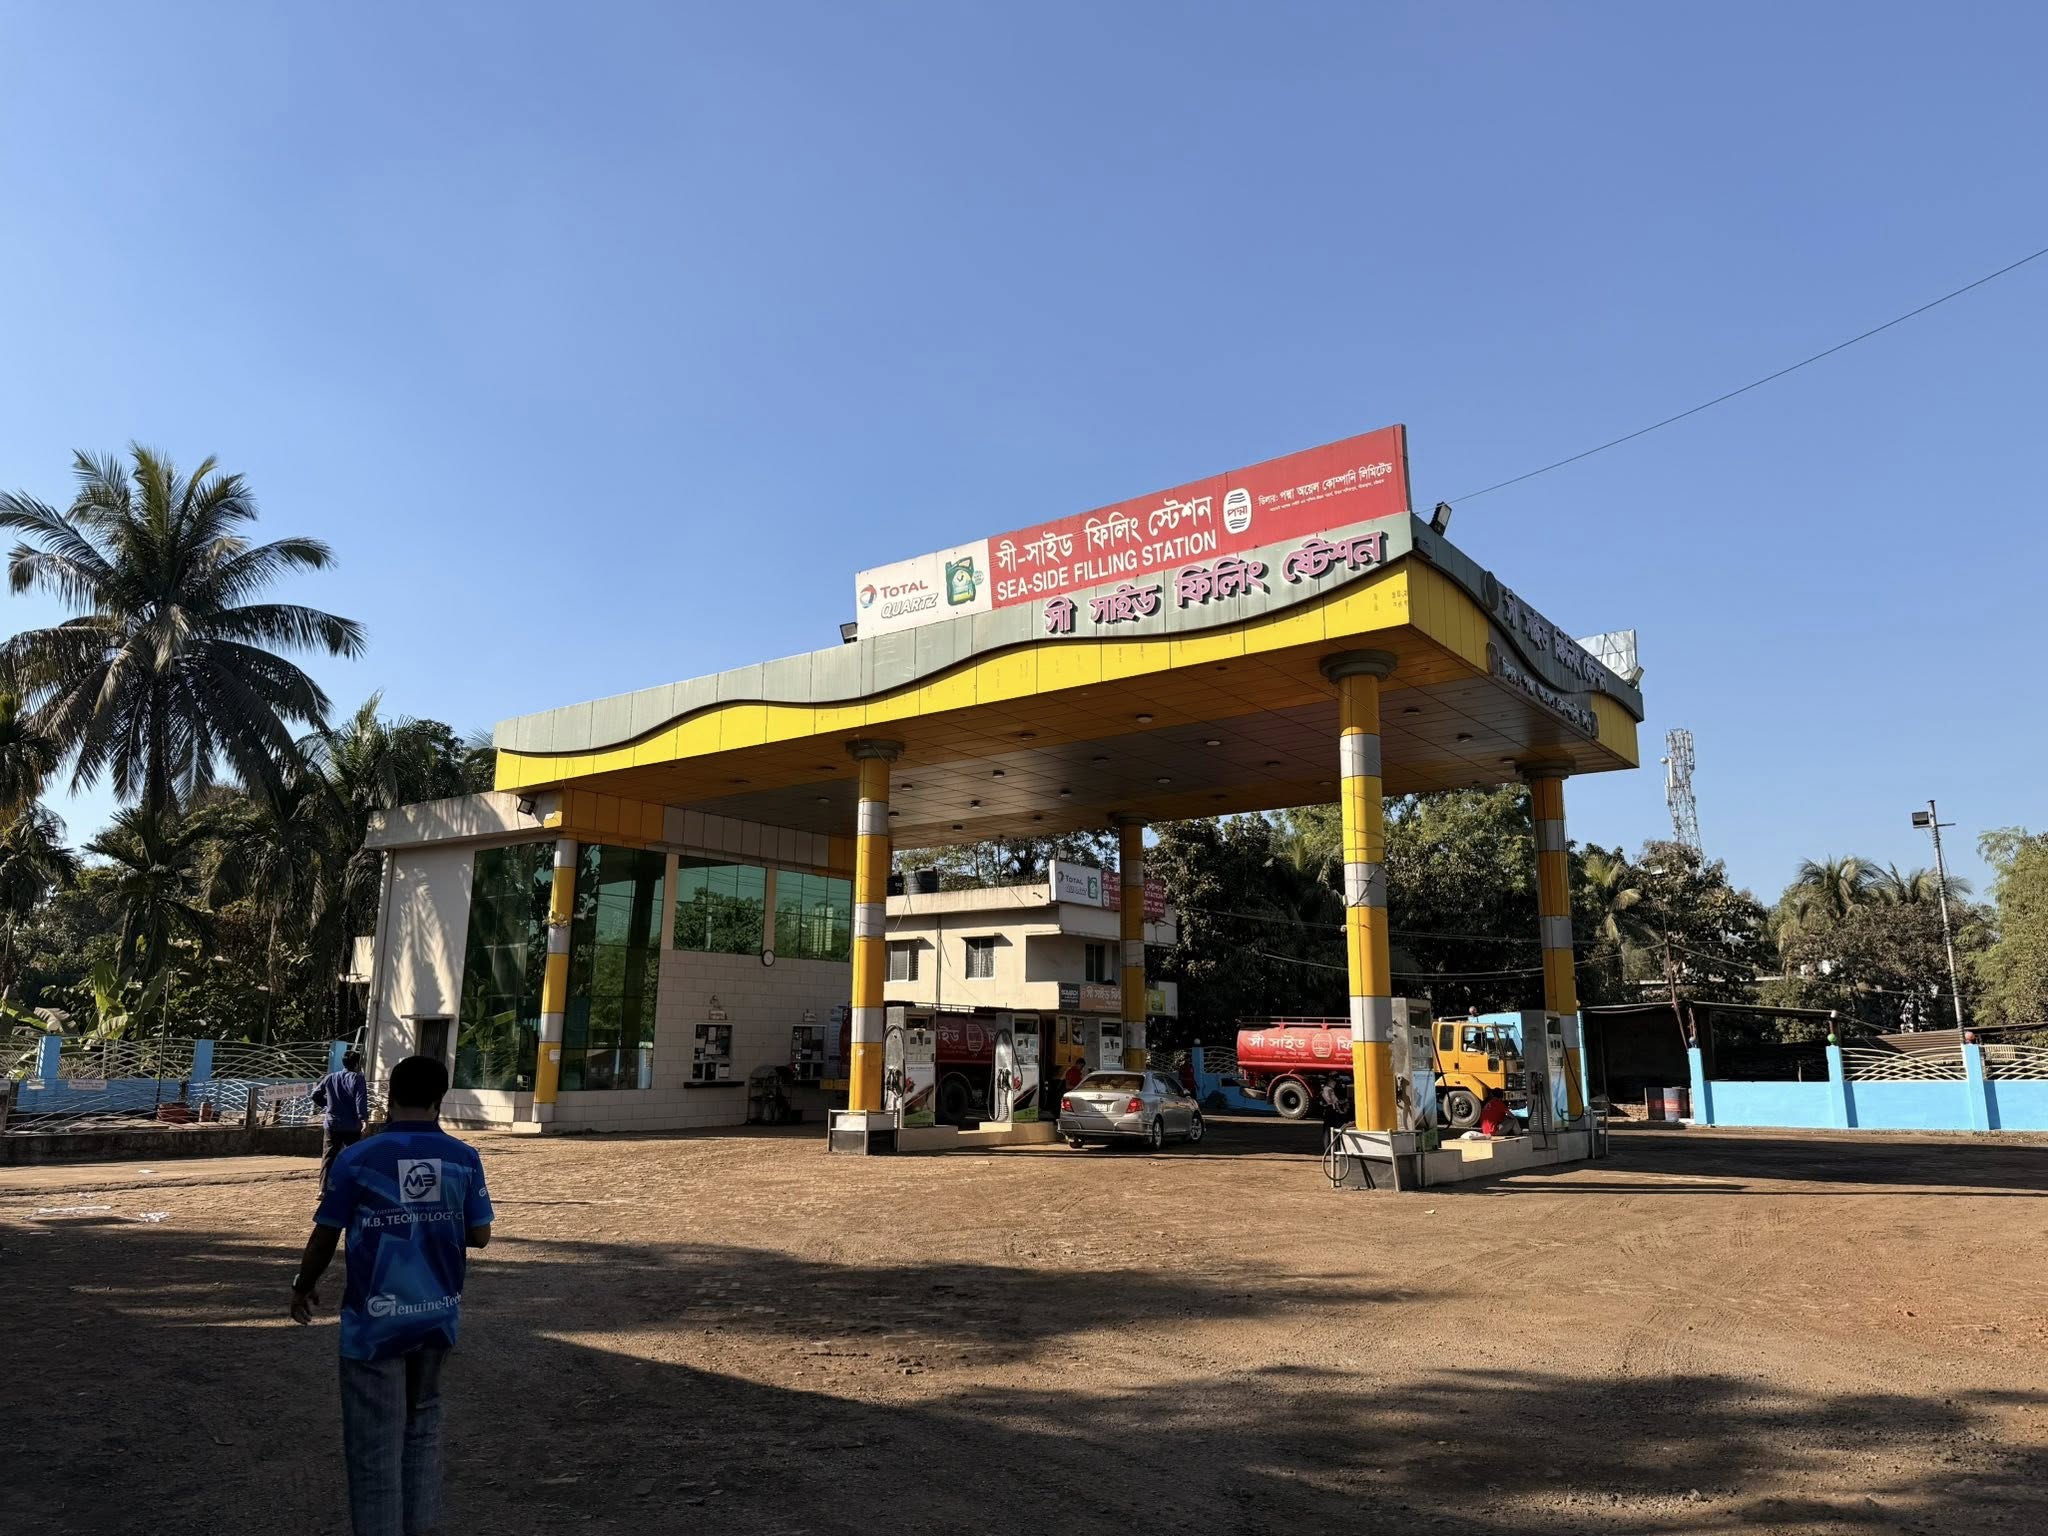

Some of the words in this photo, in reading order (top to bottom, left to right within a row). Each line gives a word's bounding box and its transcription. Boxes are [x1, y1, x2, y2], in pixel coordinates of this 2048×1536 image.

[1296, 481, 1320, 497] অয়েল
[1322, 470, 1357, 491] কোম্পানি
[1358, 462, 1393, 482] লিমিটেড
[1227, 504, 1249, 519] পদ্মা
[995, 531, 1074, 574] সী-সাইড
[1084, 511, 1143, 553] ফিলিং
[1148, 495, 1213, 537] স্টেশন
[996, 567, 1070, 601] SEA-SIDE
[1074, 551, 1138, 584] FILLING
[1142, 529, 1218, 567] STATION
[880, 579, 929, 609] TOTAL
[881, 592, 939, 619] QUARTZ
[1044, 595, 1075, 633] সী
[1090, 583, 1160, 624] সাইড
[1175, 560, 1269, 608] ফিলিং
[1065, 874, 1084, 886] TOTAL
[1248, 1033, 1265, 1048] সী
[1267, 1034, 1308, 1056] সাইড
[361, 1216, 385, 1228] M.B.
